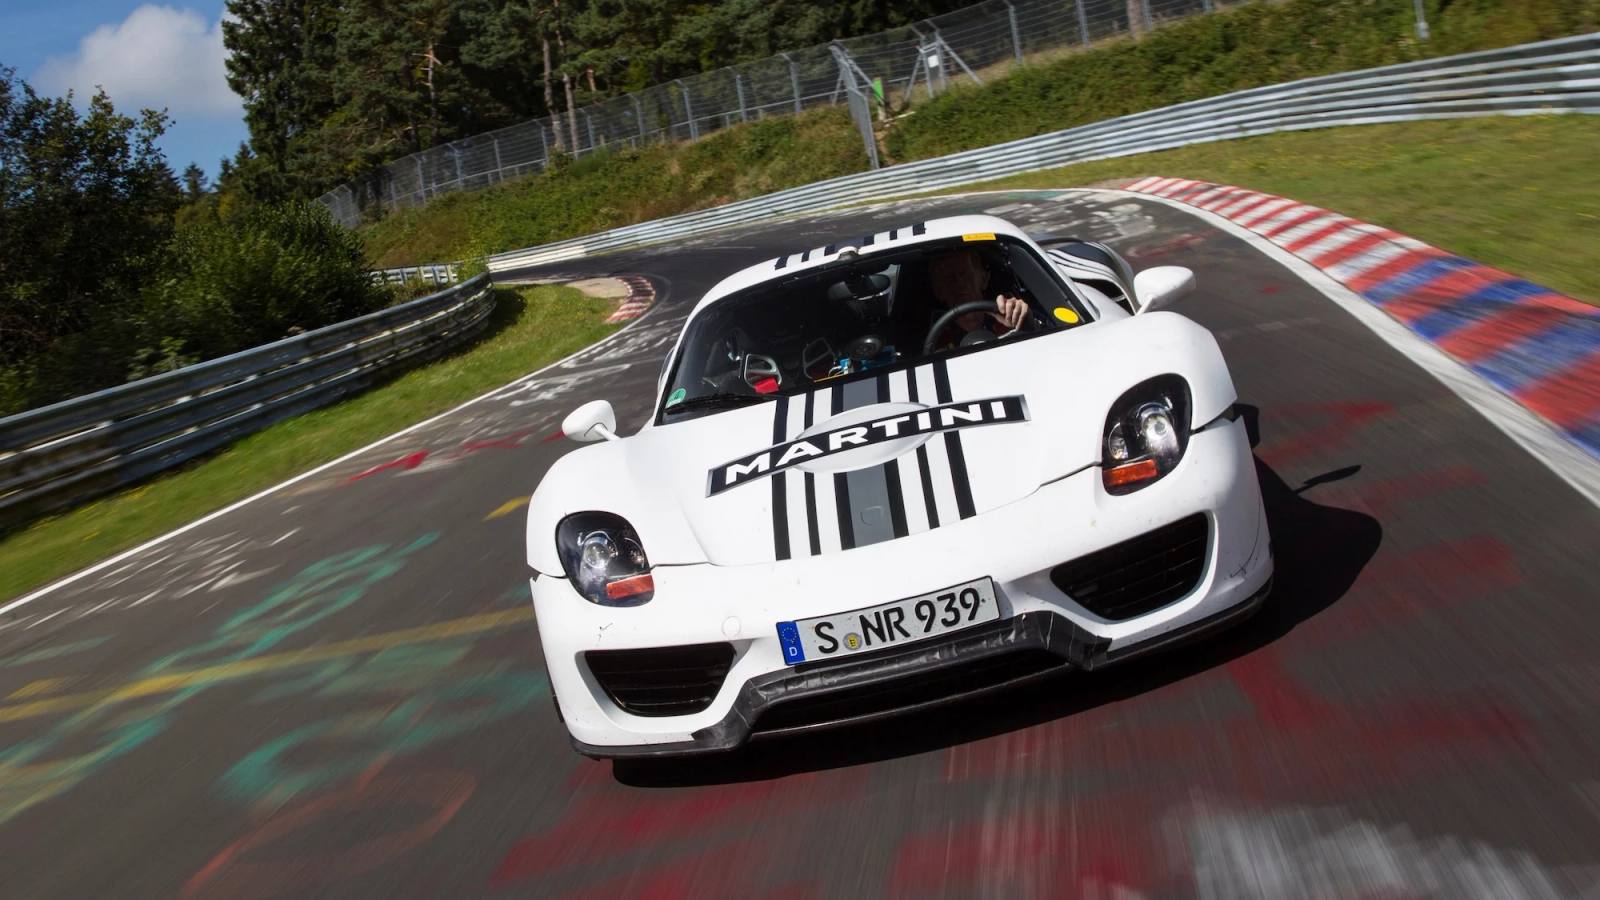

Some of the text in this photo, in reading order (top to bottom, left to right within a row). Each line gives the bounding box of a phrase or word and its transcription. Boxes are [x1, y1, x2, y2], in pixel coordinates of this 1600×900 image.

[725, 401, 1006, 485] MARTINI
[789, 646, 798, 657] D
[814, 588, 980, 653] S NR 939
